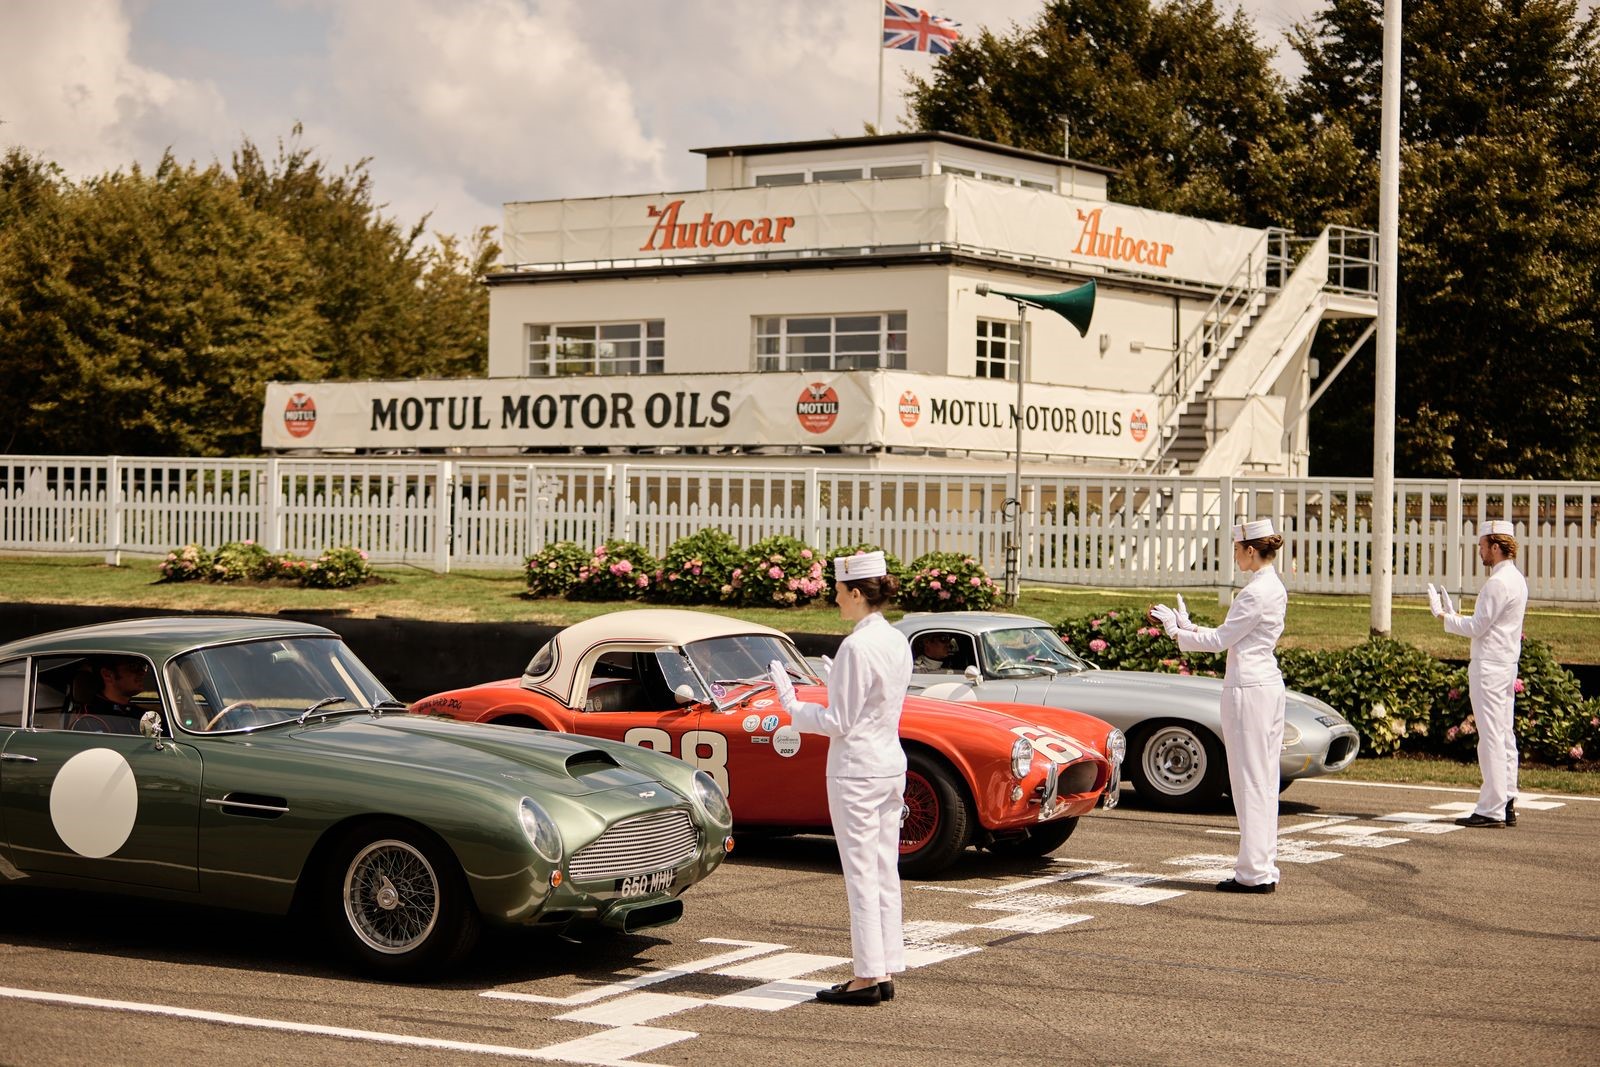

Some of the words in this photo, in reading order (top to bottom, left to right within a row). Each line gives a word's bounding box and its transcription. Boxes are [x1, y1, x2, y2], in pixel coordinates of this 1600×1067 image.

[639, 200, 795, 251] Autocar
[1071, 208, 1174, 268] Autocar
[285, 410, 316, 421] MOTUL
[370, 396, 491, 431] MOTUL
[501, 392, 635, 430] MOTOR
[645, 390, 731, 429] OILS
[799, 402, 838, 414] MOTUL
[899, 404, 920, 414] MOTUL
[930, 398, 1003, 429] MOTUL
[1081, 409, 1122, 436] OILS
[621, 875, 648, 897] 650
